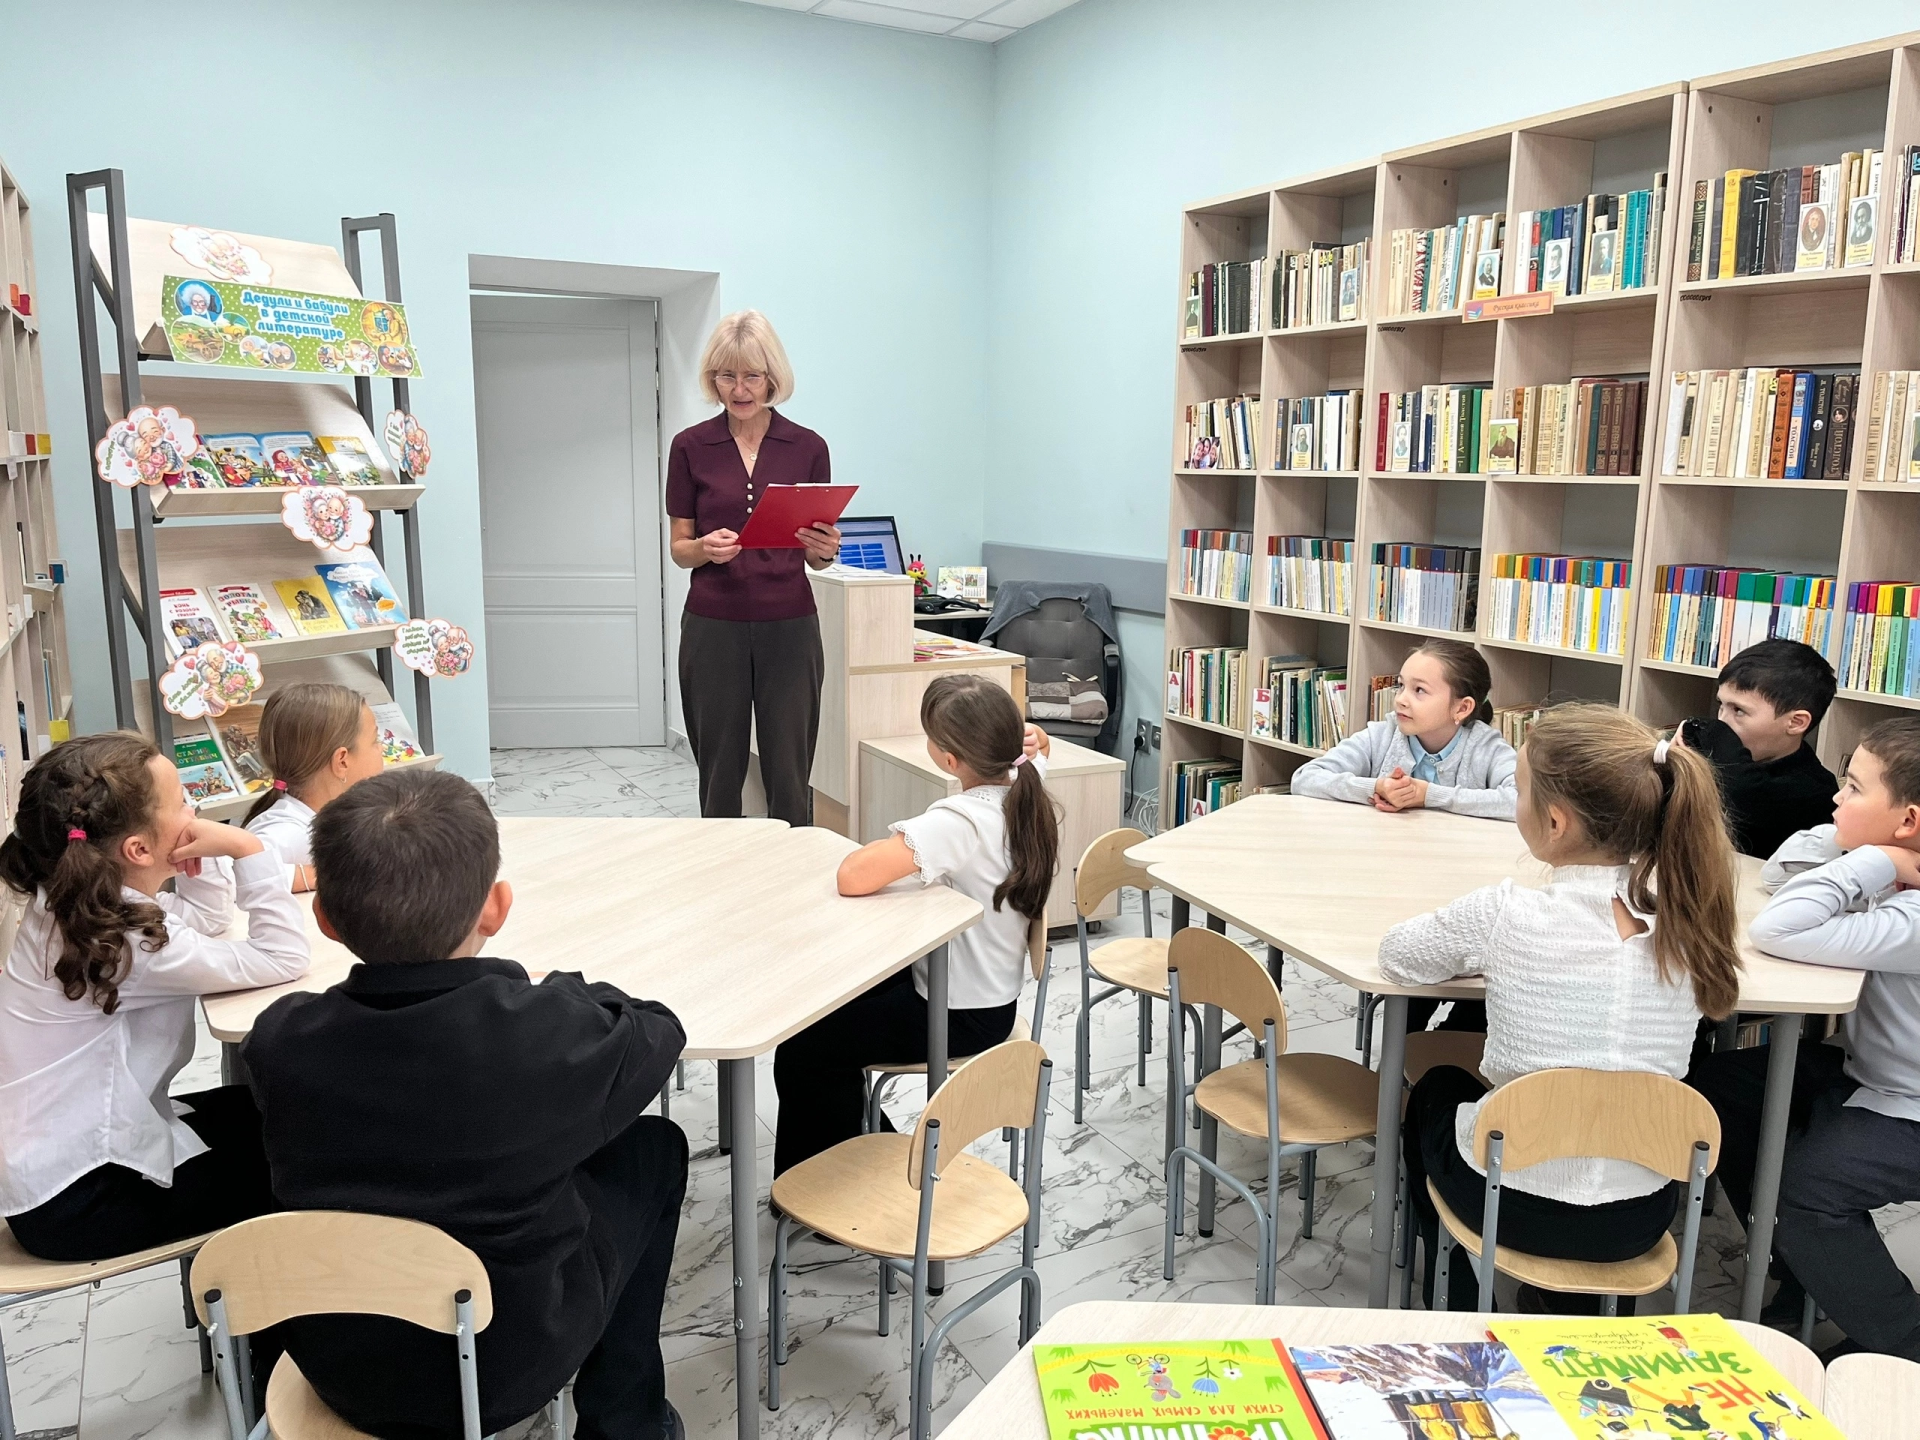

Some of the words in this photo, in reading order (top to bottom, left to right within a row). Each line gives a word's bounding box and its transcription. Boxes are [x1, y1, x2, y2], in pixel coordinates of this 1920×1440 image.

[243, 291, 292, 308] Дедули
[295, 300, 302, 308] и
[305, 299, 349, 315] бабули
[1493, 305, 1514, 313] Русская
[1515, 301, 1539, 310] классика
[261, 308, 269, 317] в
[274, 310, 331, 325] детской
[258, 322, 344, 340] литературе
[1817, 388, 1826, 414] ТОЛСТОЙ
[1788, 426, 1797, 459] ТОЛСТОЙ
[1831, 430, 1844, 472] ТОЛСТОЙ
[218, 592, 258, 602] ЗОЛОТАЯ
[1169, 672, 1179, 686] А
[1256, 689, 1270, 702] Б
[177, 753, 217, 765] ОТТАБЫЧ
[1541, 1349, 1753, 1380] ЗАНИМАТЬ
[1693, 1375, 1765, 1410] НЕ
